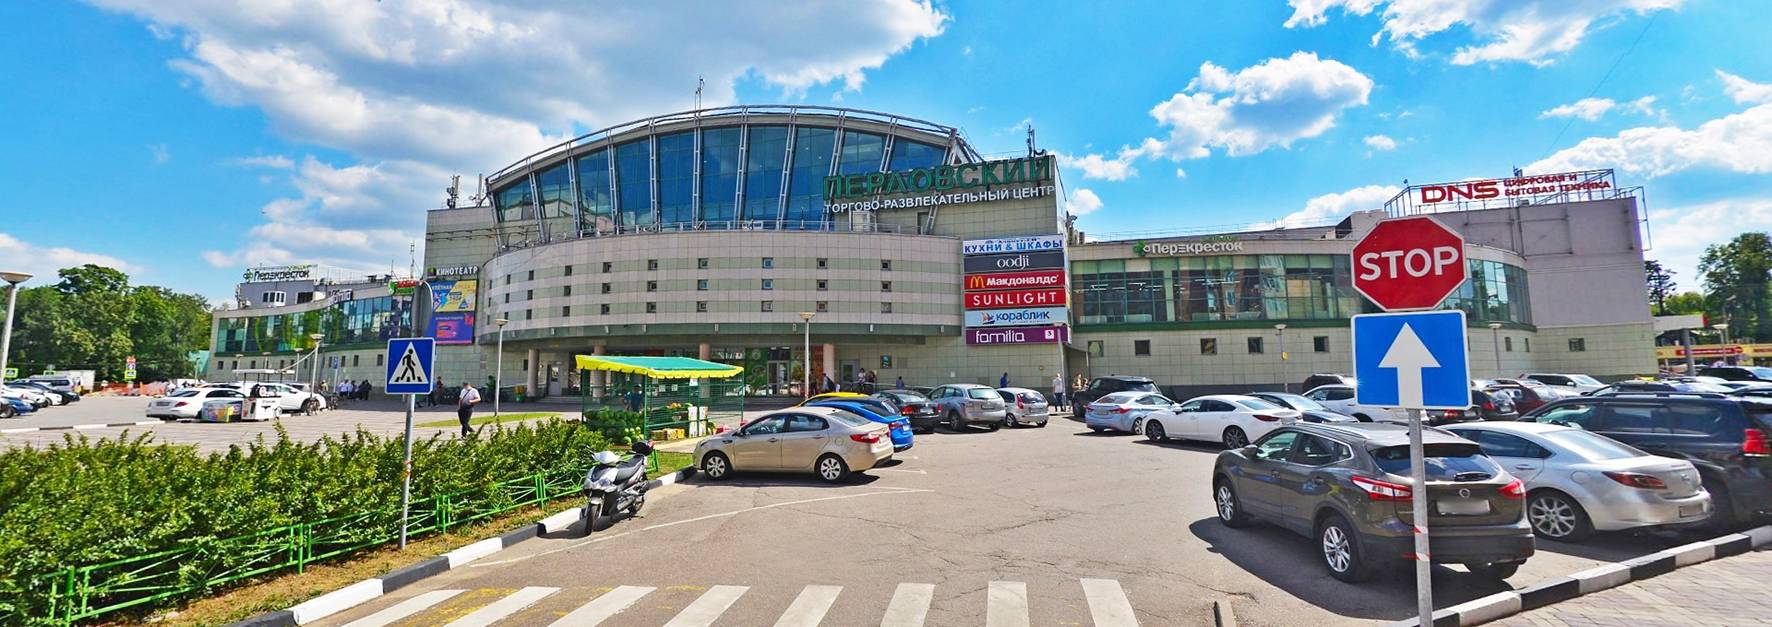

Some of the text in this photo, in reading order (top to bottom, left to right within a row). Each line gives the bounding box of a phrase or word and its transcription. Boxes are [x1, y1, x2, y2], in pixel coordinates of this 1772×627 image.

[823, 156, 1053, 200] ПЕРЛОВСКИЙ
[1503, 175, 1565, 187] ЦИФРОВАЯ
[1421, 181, 1499, 203] DNS
[1504, 181, 1611, 196] БЫТОВАЯ ТЕХНИКА
[824, 186, 1055, 214] ТОРГОВО-РАЗВЛЕКАТЕЛЬНЫЙ ЦЕНТР
[964, 243, 1002, 253] КУХНИ
[1017, 240, 1062, 250] ШКАФЫ
[997, 255, 1029, 269] oodji
[1359, 246, 1459, 281] STOP
[436, 265, 478, 276] КИНОТЕАТР
[973, 292, 1057, 306] SUNLIGHT
[996, 311, 1050, 323] кораблик
[976, 330, 1025, 344] familia
